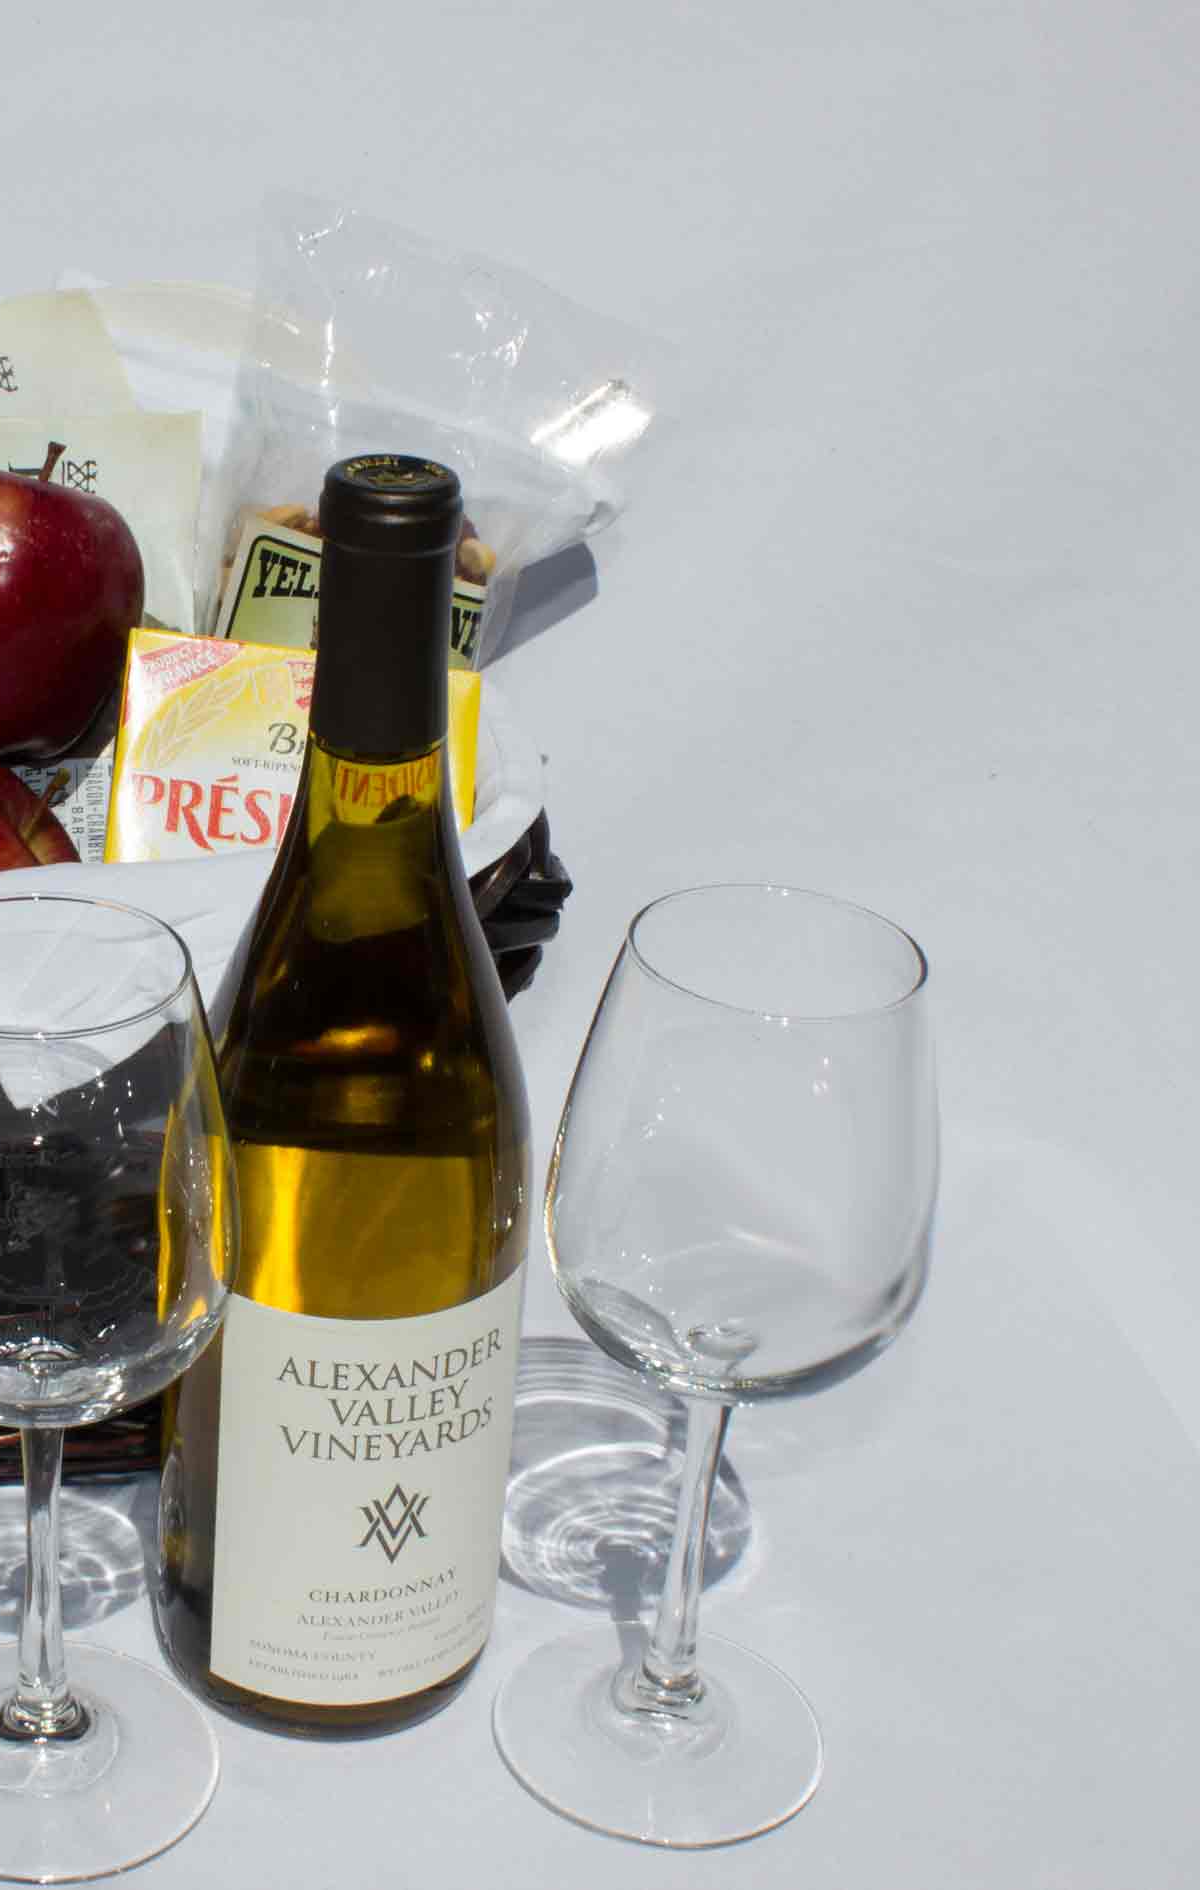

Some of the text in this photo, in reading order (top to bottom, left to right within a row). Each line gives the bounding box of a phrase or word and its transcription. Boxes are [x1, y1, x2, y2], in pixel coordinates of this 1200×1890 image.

[71, 806, 85, 834] BAR
[277, 1328, 503, 1391] ALEXANDER
[328, 1378, 470, 1426] VALLEY
[280, 1397, 493, 1461] VINEYARDS
[308, 1567, 456, 1604] CHARDONNAY
[297, 1606, 404, 1627] ALEXANDER
